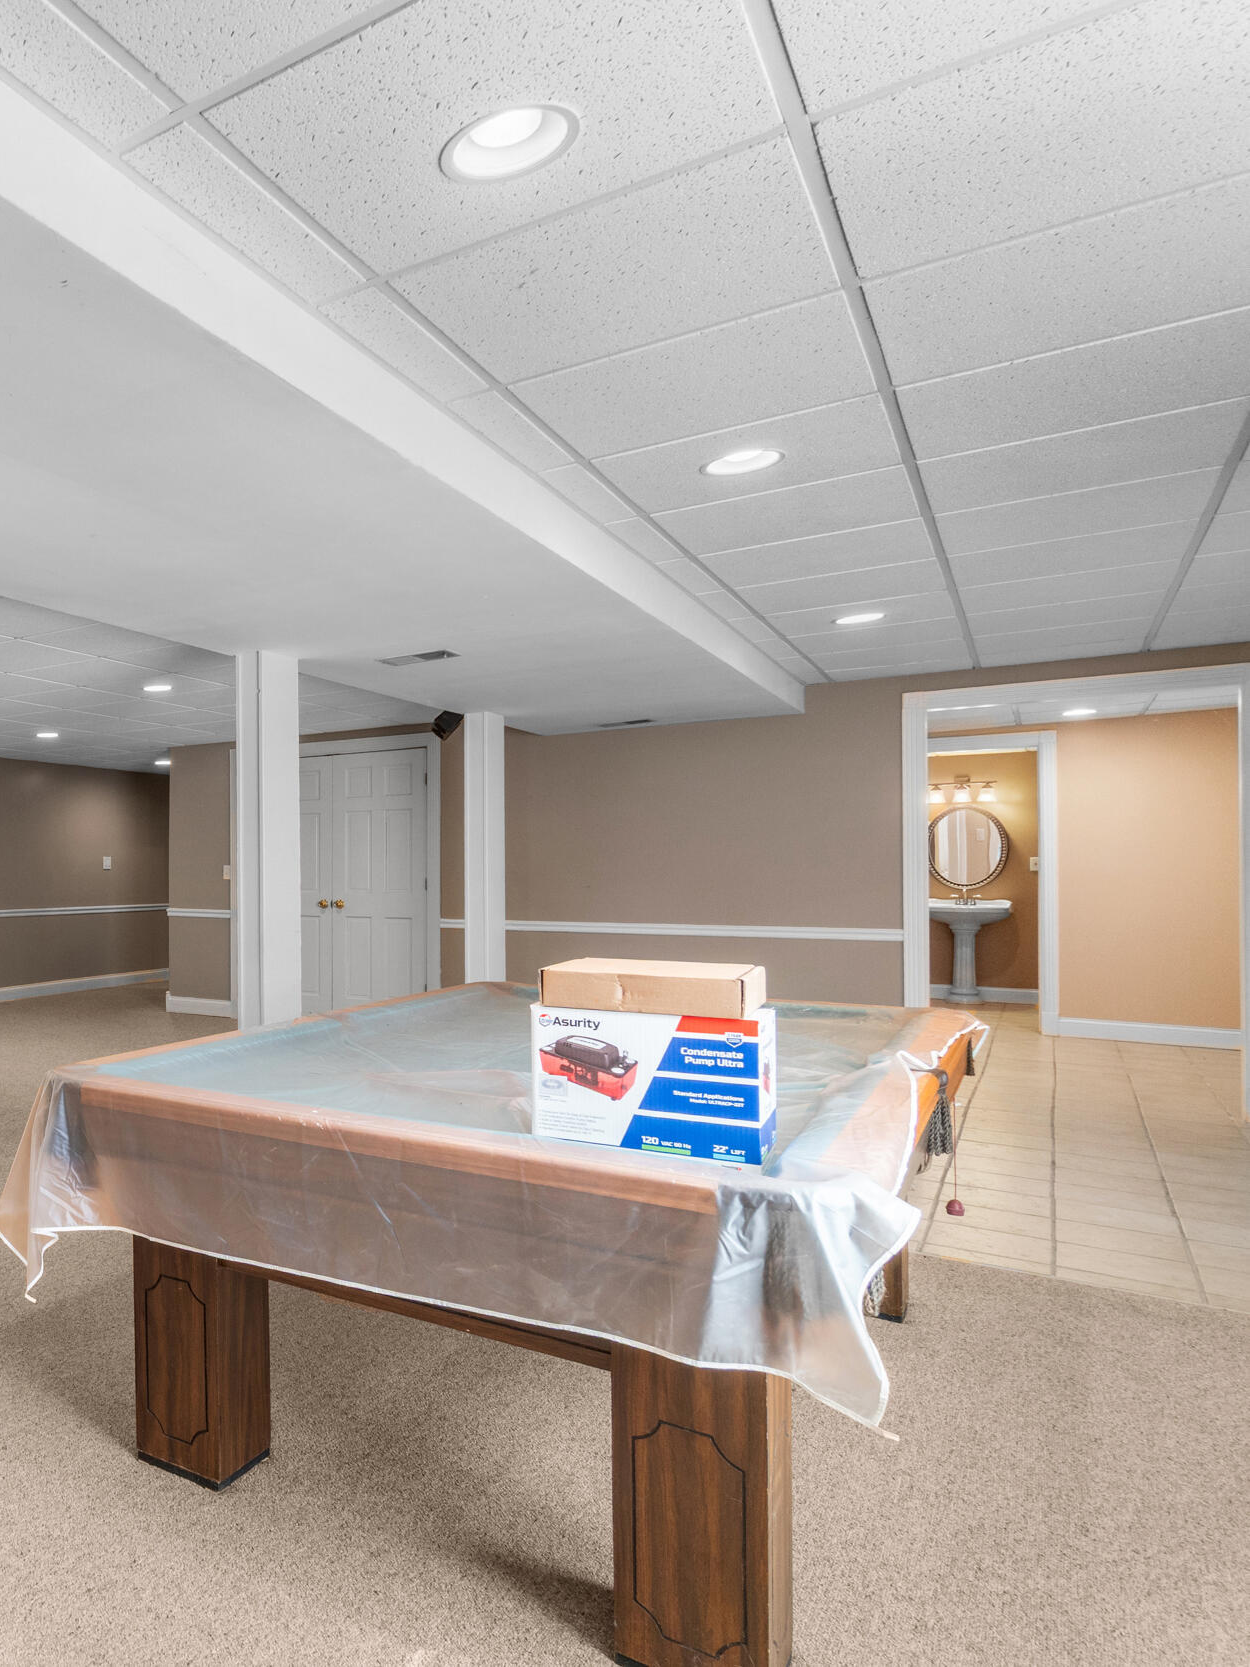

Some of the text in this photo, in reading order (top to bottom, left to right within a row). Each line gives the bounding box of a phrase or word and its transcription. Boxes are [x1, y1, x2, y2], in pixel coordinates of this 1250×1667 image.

[553, 1016, 600, 1031] Asurity
[680, 1047, 744, 1059] Condensate
[684, 1056, 744, 1068] Pump Ultra
[673, 1090, 745, 1102] Standard Applications
[641, 1136, 659, 1145] 120
